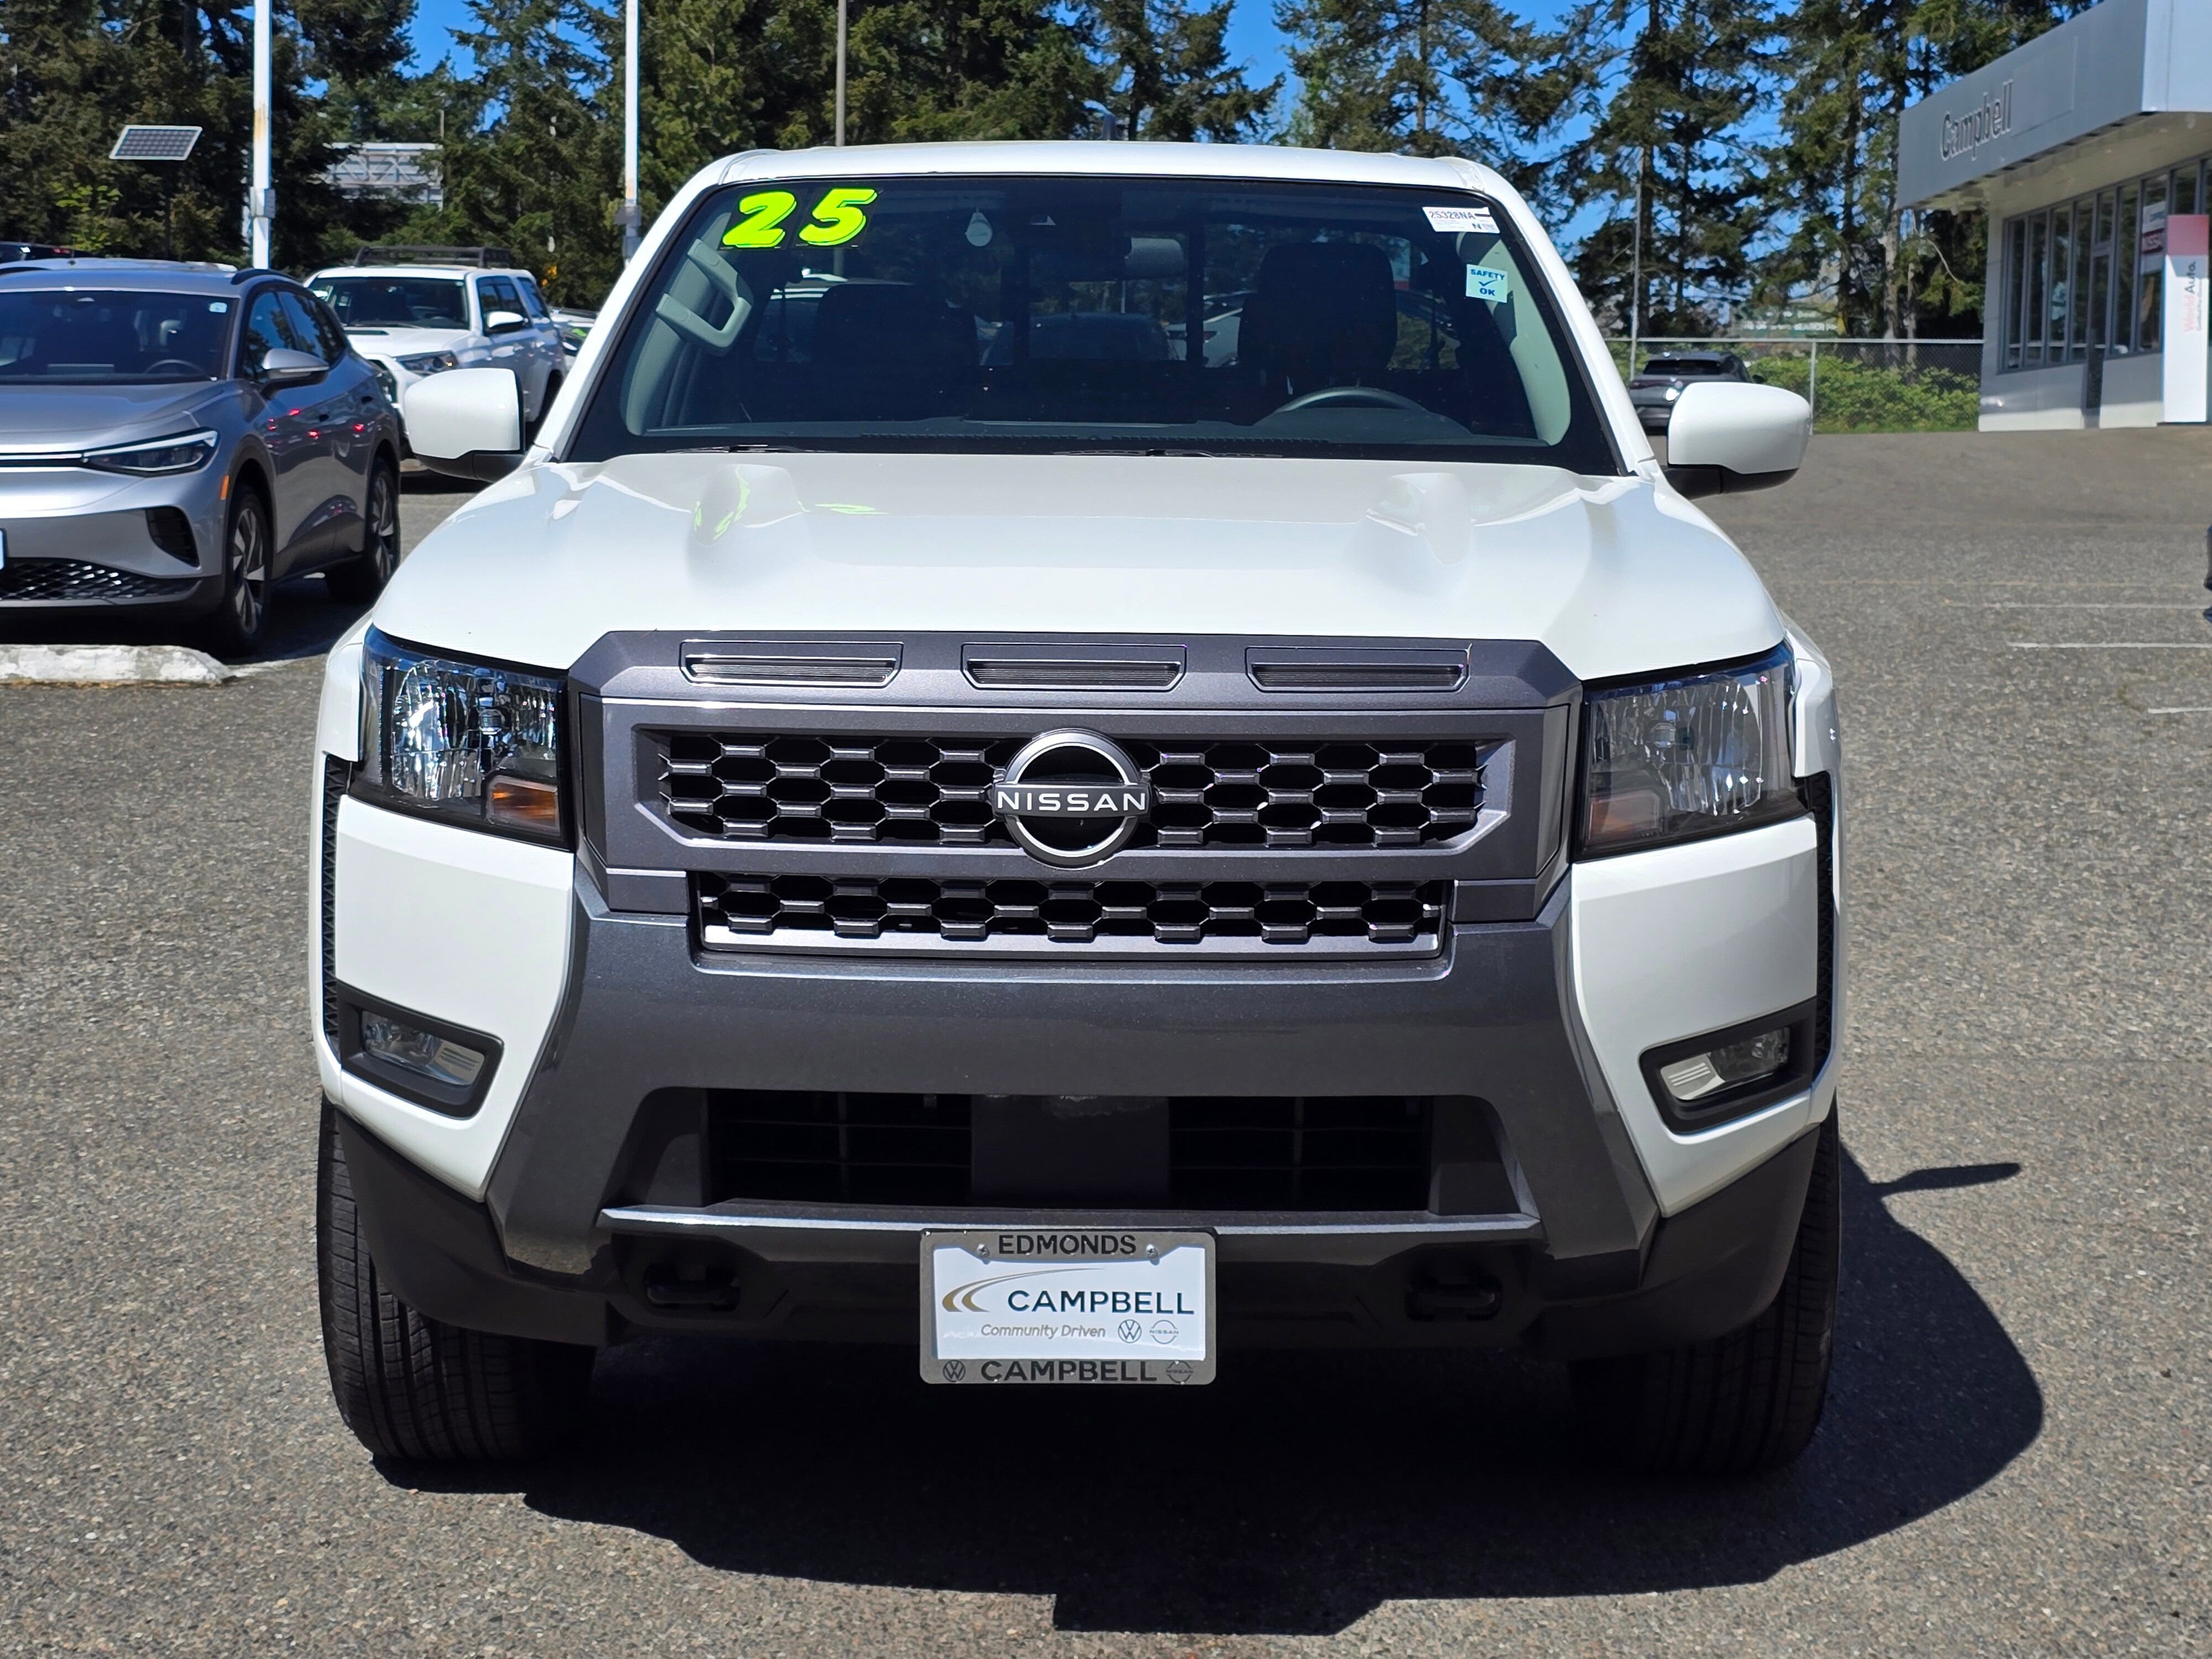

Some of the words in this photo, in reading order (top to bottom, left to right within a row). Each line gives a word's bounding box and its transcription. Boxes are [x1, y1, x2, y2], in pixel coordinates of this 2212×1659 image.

[1941, 79, 2013, 161] Campbell
[722, 189, 878, 248] 25
[1470, 269, 1505, 280] SAFETY
[1479, 288, 1495, 296] OK
[997, 791, 1145, 811] NISSAN
[999, 1234, 1136, 1255] EDMONDS
[1008, 1290, 1194, 1315] CAMPBELL
[981, 1324, 1057, 1340] Community
[1062, 1326, 1106, 1338] Driven
[981, 1360, 1157, 1382] CAMPBELL
